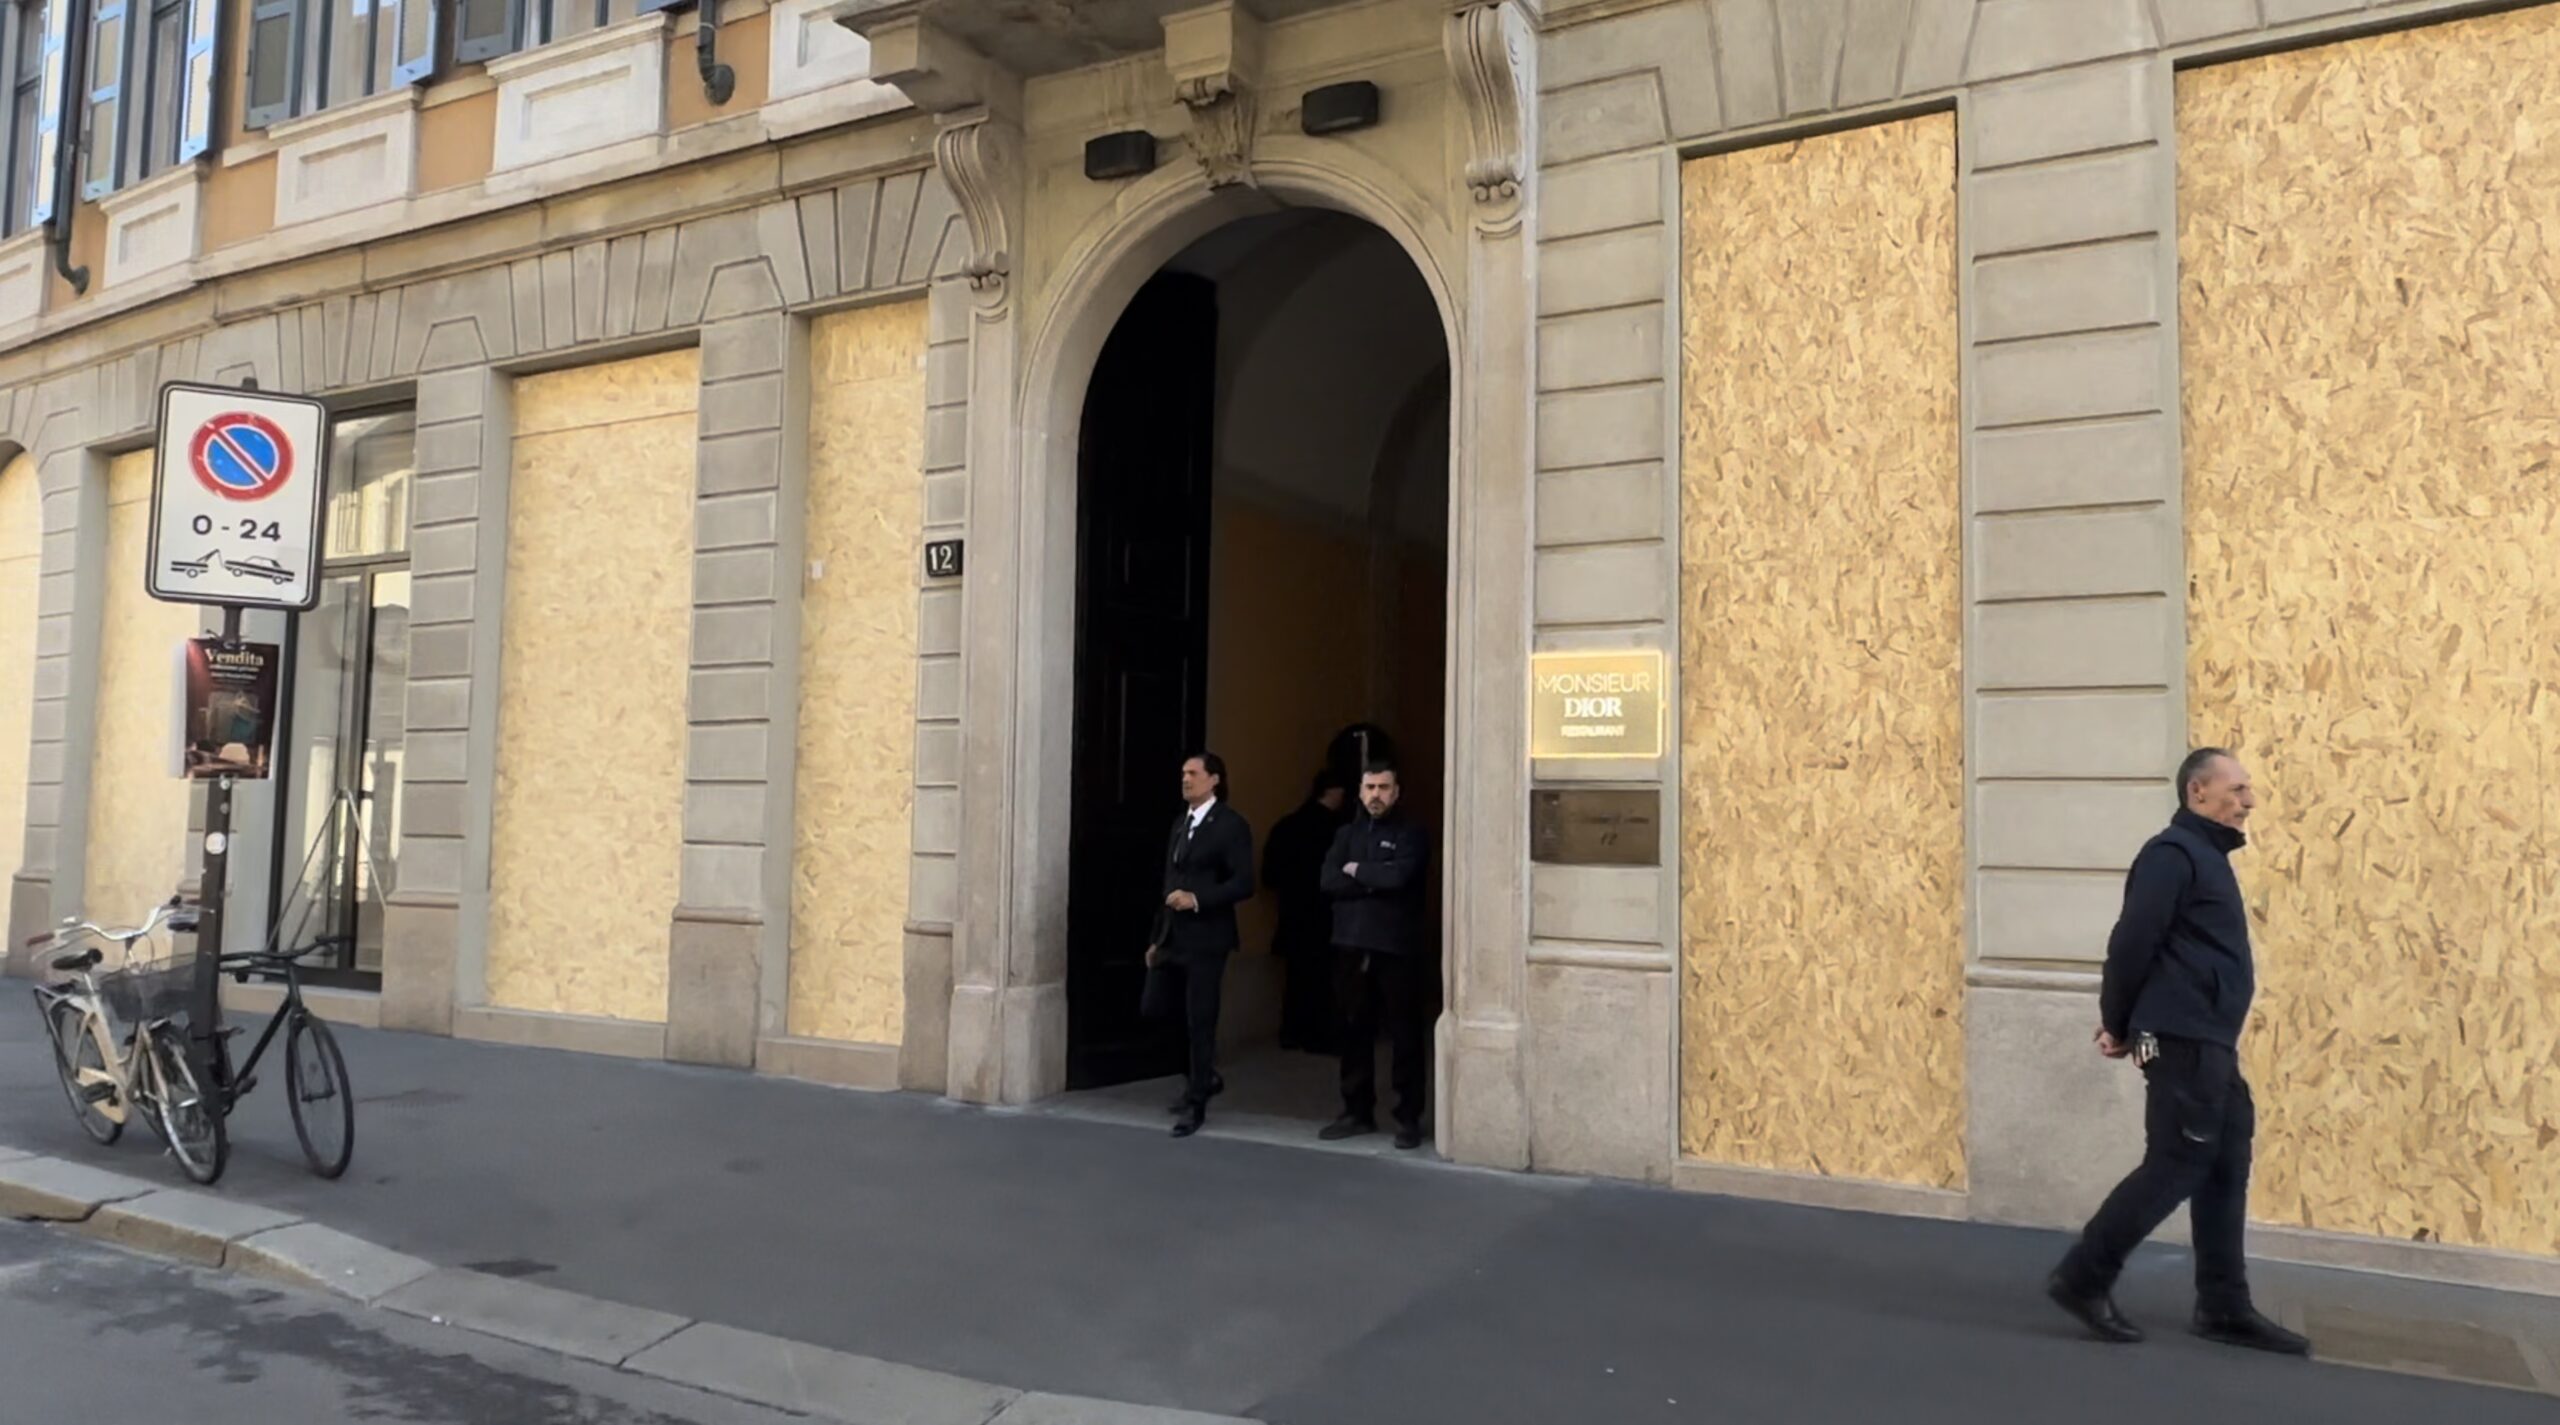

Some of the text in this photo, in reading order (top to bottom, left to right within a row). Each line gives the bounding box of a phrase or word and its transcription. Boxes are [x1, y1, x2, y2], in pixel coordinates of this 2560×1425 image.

[192, 514, 212, 535] 0
[239, 519, 281, 541] 24
[929, 545, 953, 571] 12
[205, 648, 264, 667] Vendita
[1537, 671, 1651, 694] MONSIEUR
[1563, 696, 1623, 718] DIOR
